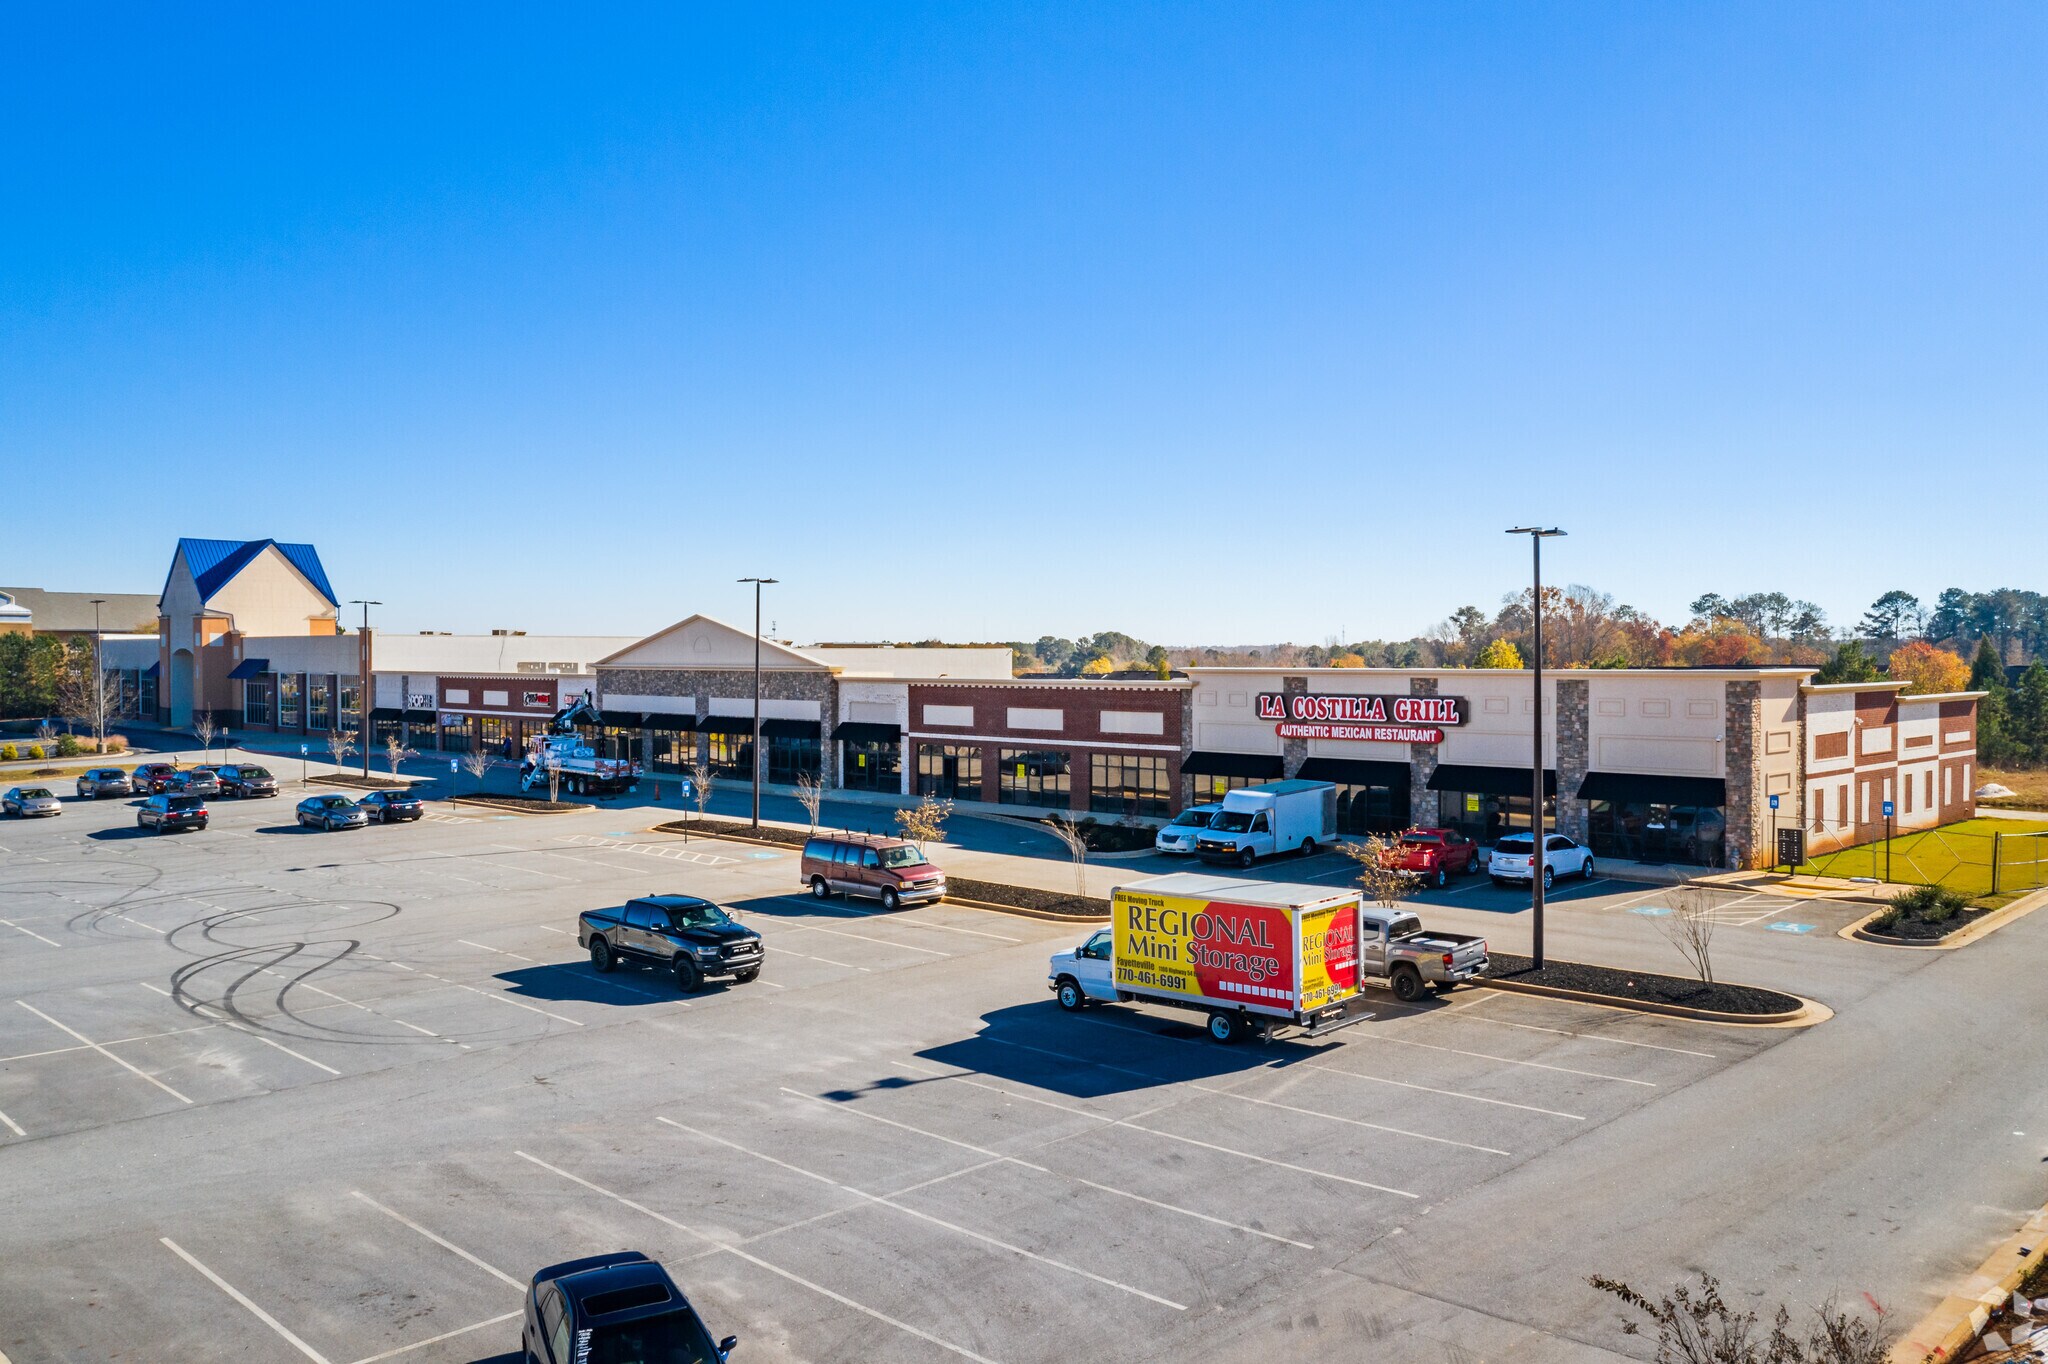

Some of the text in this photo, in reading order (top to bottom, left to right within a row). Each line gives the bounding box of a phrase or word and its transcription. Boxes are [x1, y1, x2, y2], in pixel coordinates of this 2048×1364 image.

[1260, 695, 1459, 724] LA COSTILLA GRILL
[1280, 724, 1437, 742] AUTHENTIC MEXICAN RESTAURANT
[1115, 893, 1164, 907] FREE Moving Truck
[1128, 905, 1275, 949] REGIONAL
[1302, 924, 1354, 952] REGIONAL
[1117, 956, 1155, 971] Fayetteville
[1127, 933, 1280, 982] Mini Storage
[1302, 944, 1357, 966] Mini Storage
[1117, 967, 1187, 990] 770-461-6991
[1303, 982, 1341, 1004] 770-461-6991
